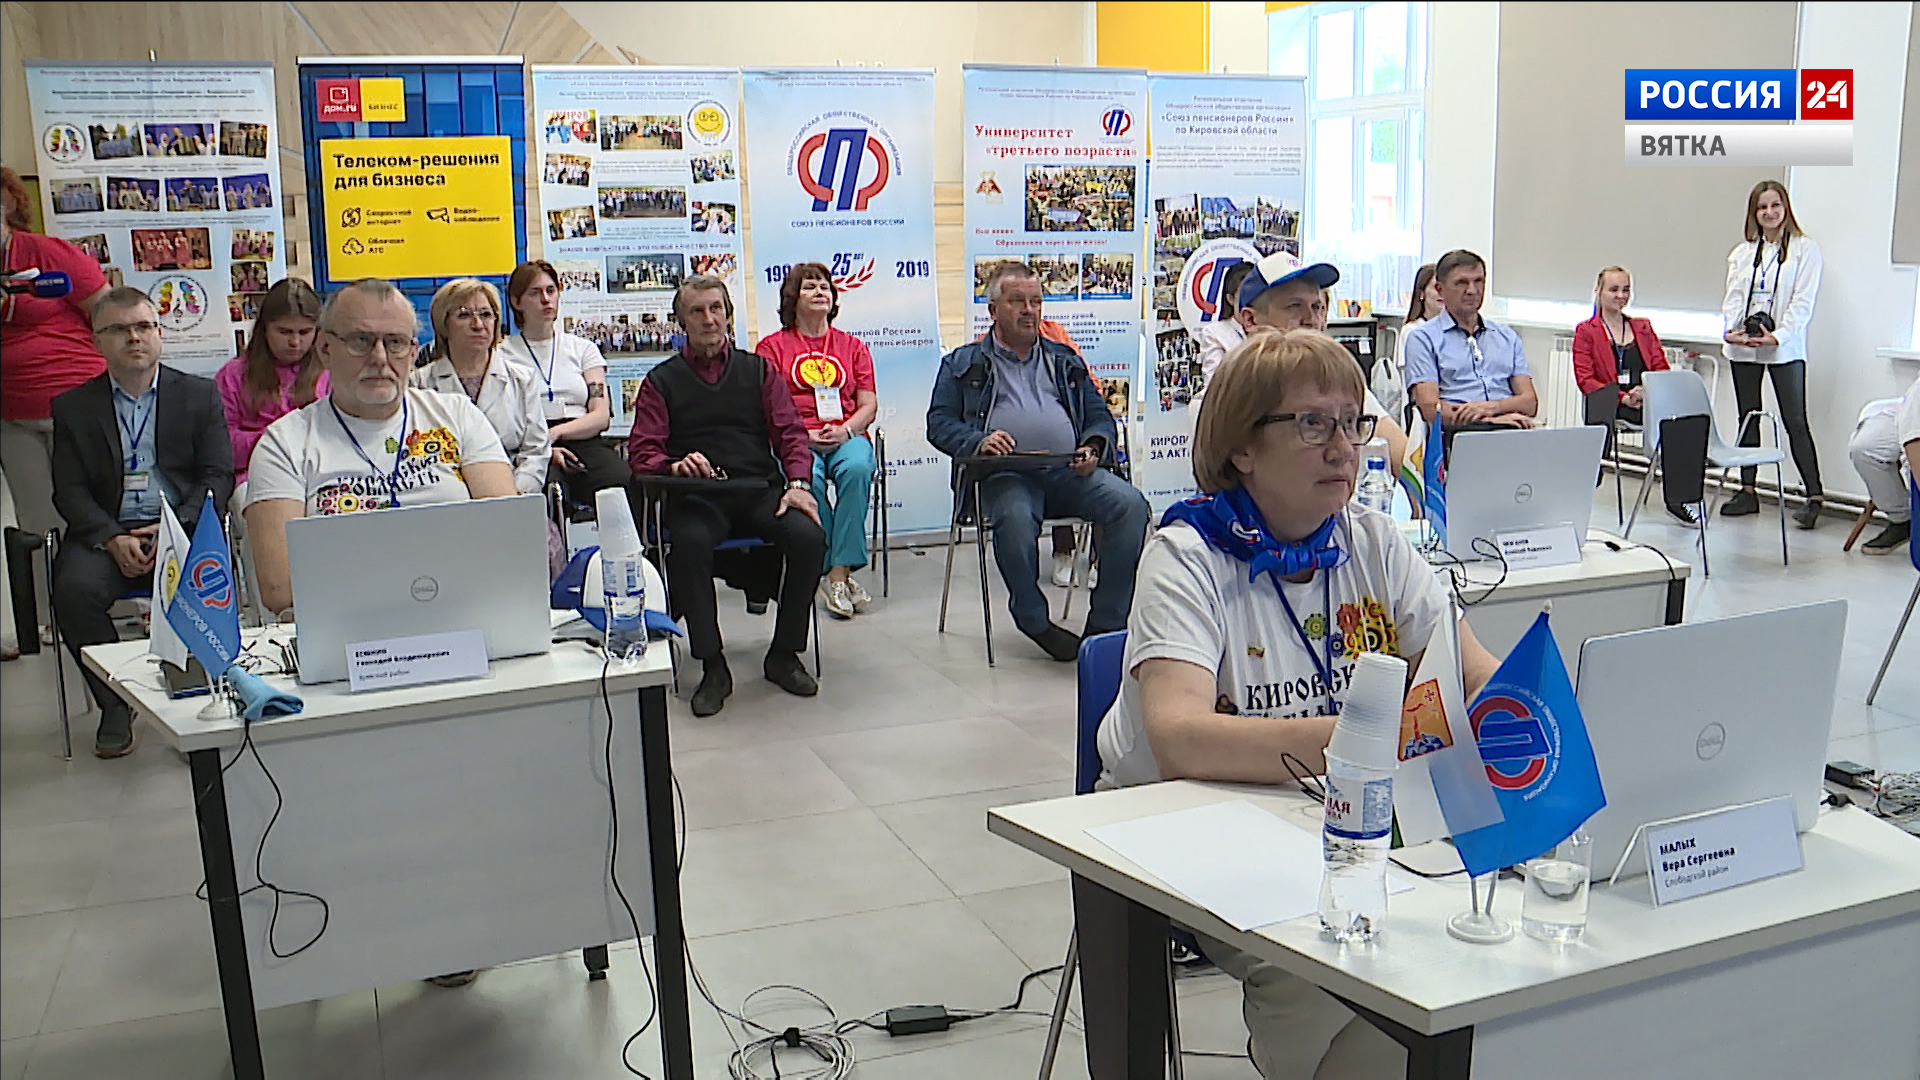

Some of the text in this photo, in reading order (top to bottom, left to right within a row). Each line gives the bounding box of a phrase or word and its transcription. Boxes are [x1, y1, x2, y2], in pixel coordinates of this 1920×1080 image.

[1161, 112, 1294, 123] «Союз пенсионеров России»
[975, 126, 1074, 140] Университет
[1190, 126, 1238, 135] Кировской
[1240, 126, 1278, 135] области
[986, 145, 1137, 159] «третьего возраста»
[333, 153, 500, 169] Телеком-решения
[334, 172, 446, 190] для бизнеса
[791, 217, 905, 228] СОЮЗ ПЕНСИОНЕРОВ РОССИИ
[831, 253, 852, 276] 25
[896, 261, 930, 278] 2019
[1245, 663, 1356, 710] КИРОВСК
[1659, 838, 1696, 856] МАЛЫХ
[1663, 847, 1735, 872] Вера Сергеевна
